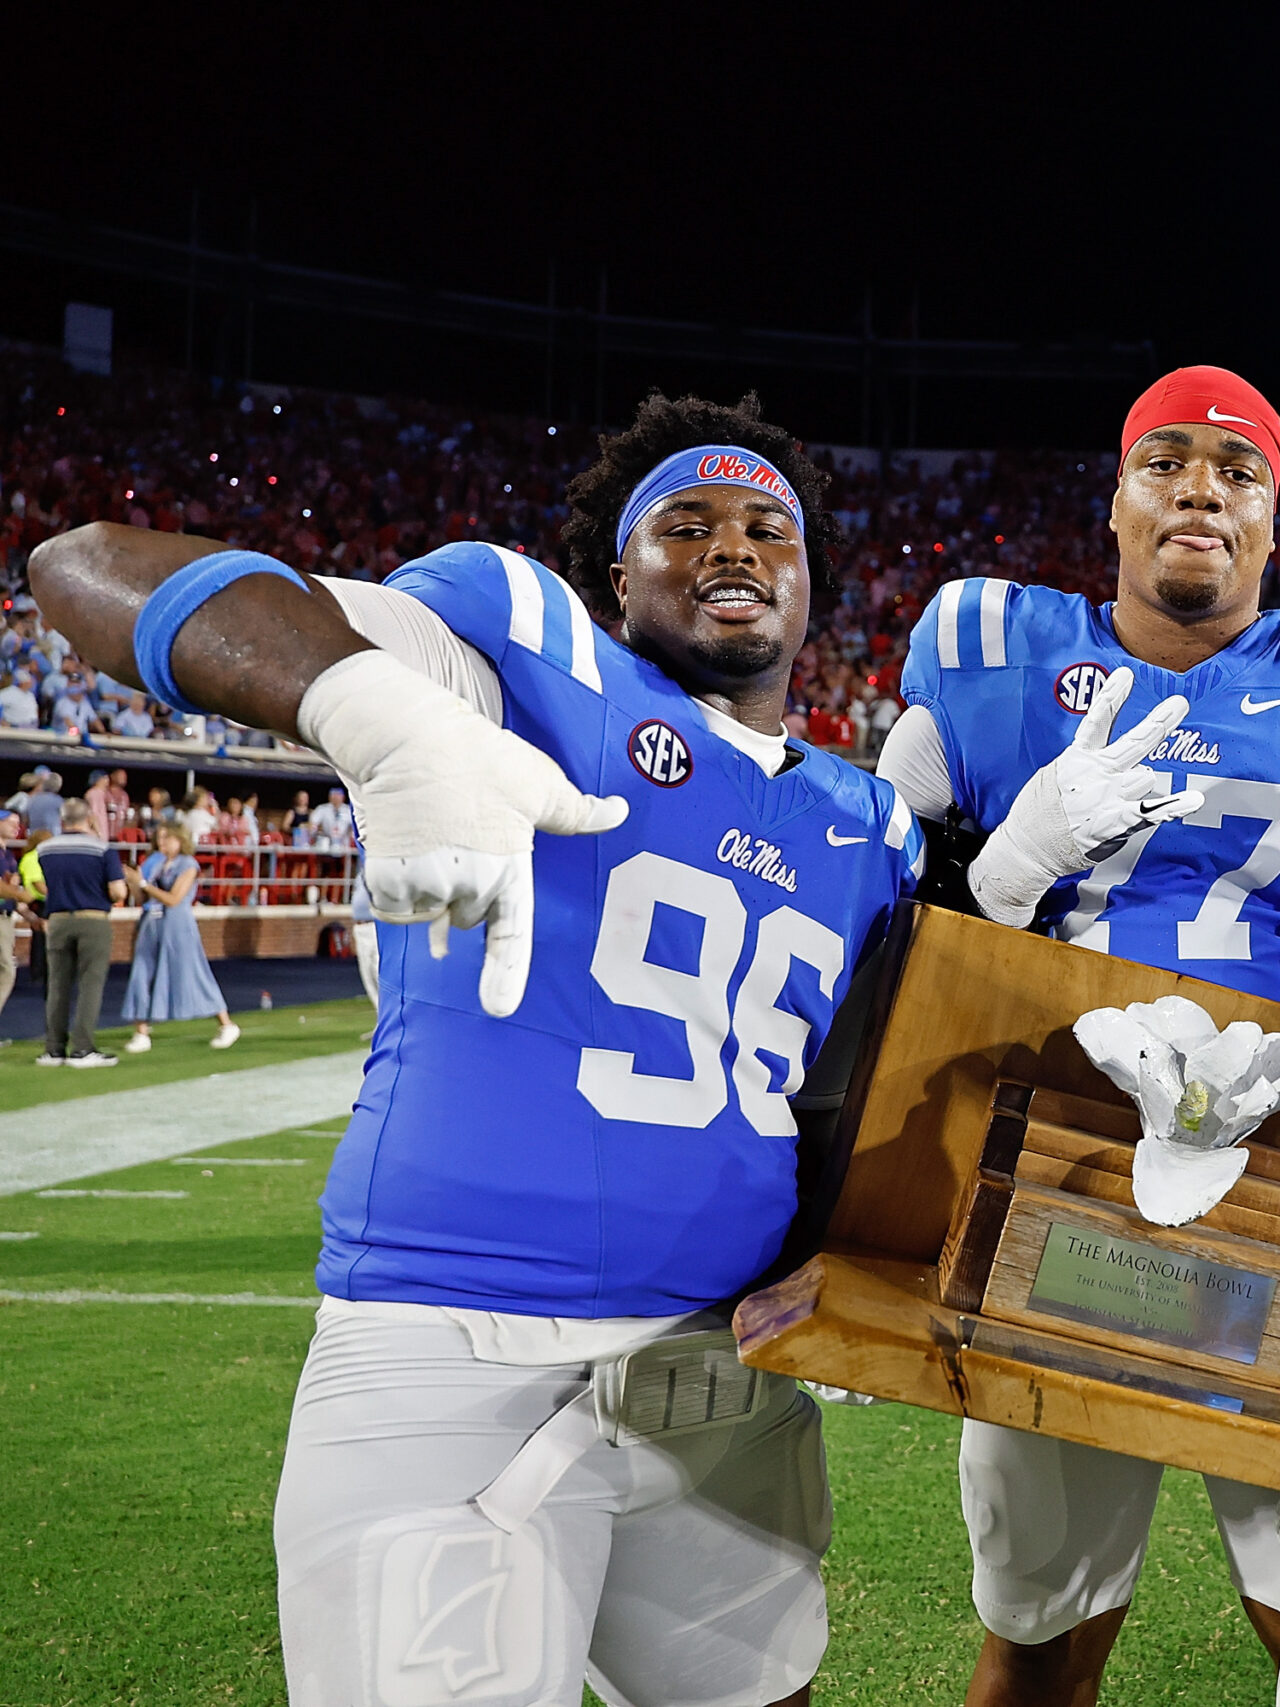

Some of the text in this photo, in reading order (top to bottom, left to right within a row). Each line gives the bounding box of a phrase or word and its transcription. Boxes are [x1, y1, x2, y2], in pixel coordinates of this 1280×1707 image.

[697, 455, 748, 481] Ole
[634, 724, 688, 783] SEC
[1167, 729, 1220, 764] Miss
[717, 828, 798, 893] Ole Miss
[576, 850, 845, 1138] 96
[1068, 1236, 1254, 1300] THE MAGNOLIA BOWL
[1076, 1273, 1095, 1288] THE
